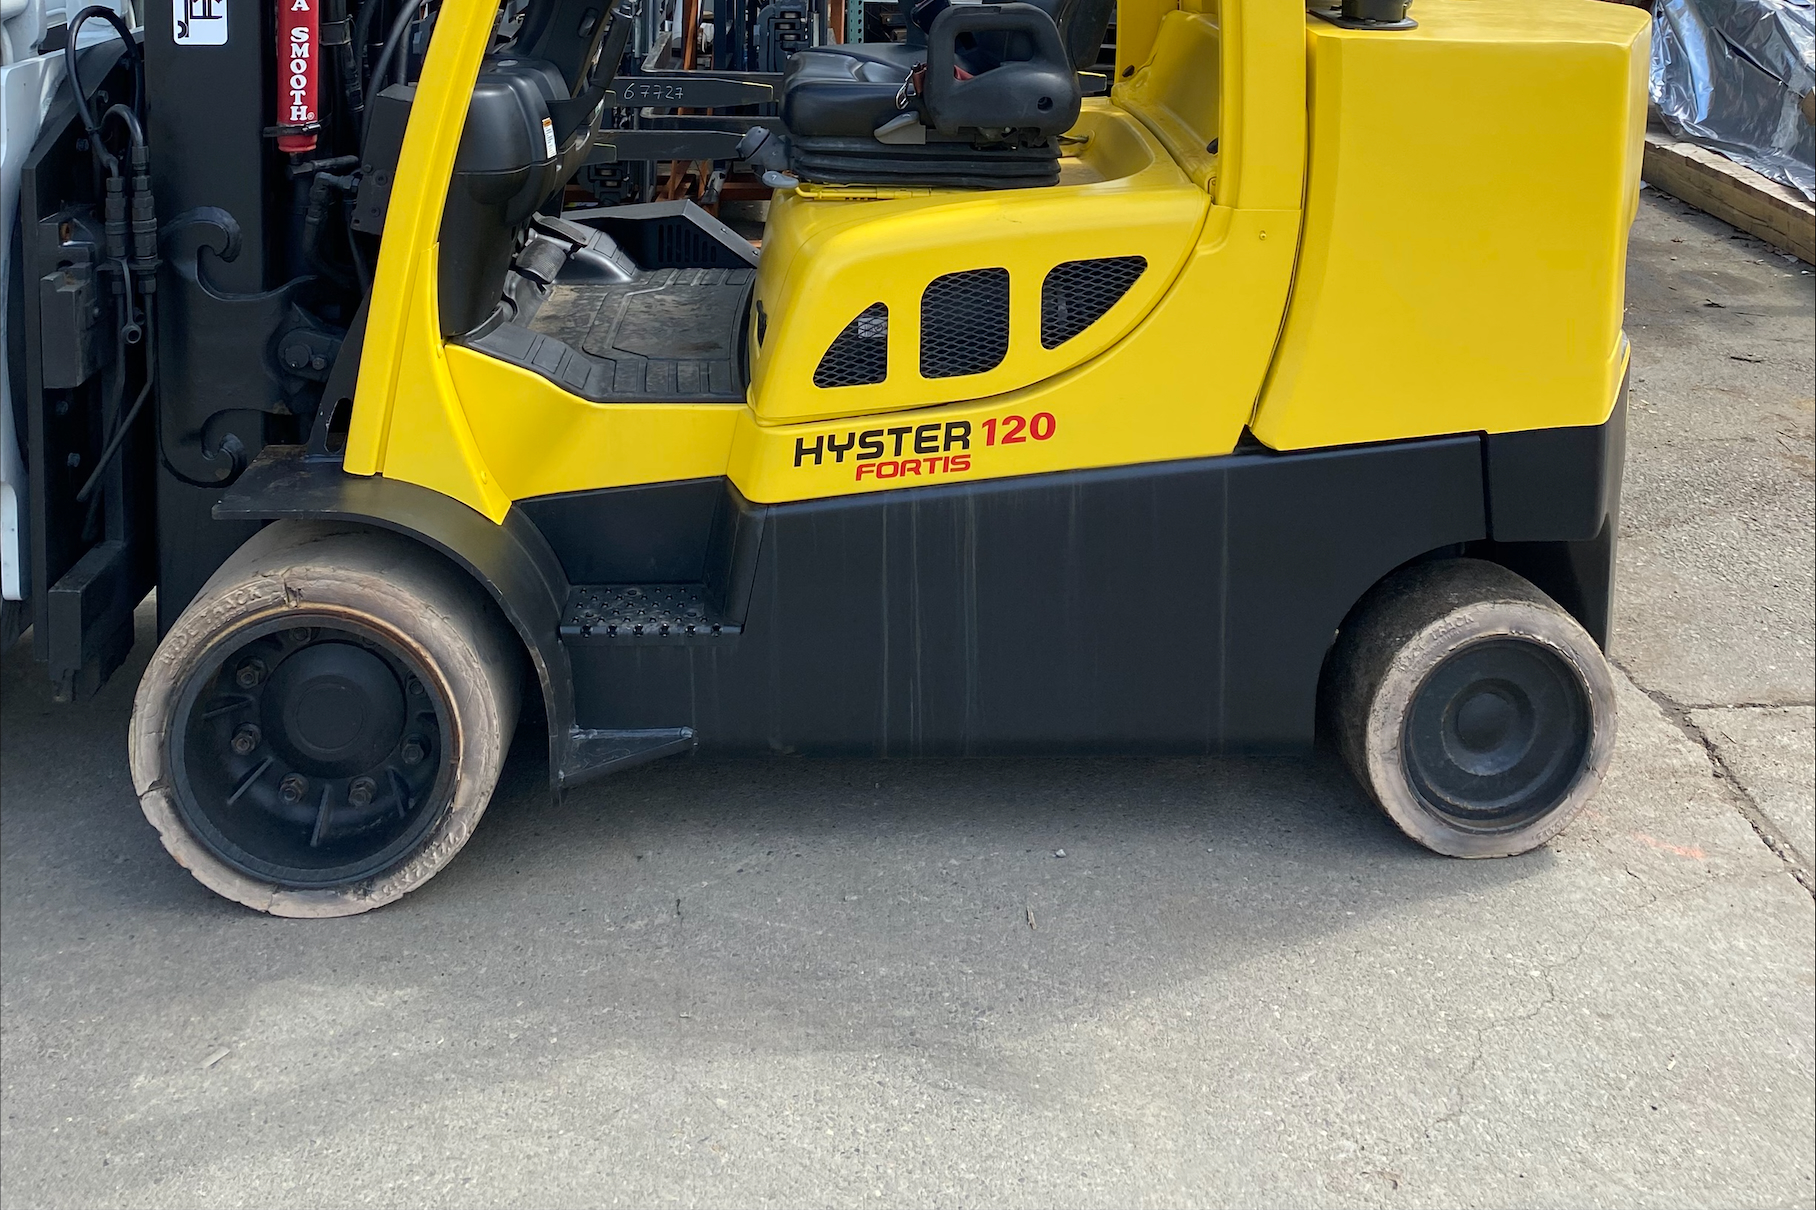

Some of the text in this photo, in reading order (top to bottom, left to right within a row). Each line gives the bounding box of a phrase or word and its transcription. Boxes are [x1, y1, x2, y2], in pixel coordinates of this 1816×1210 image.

[289, 26, 310, 121] SMOOTH
[623, 82, 685, 101] 67727
[794, 412, 1056, 467] HYSTER 120
[855, 454, 971, 481] FORTIS
